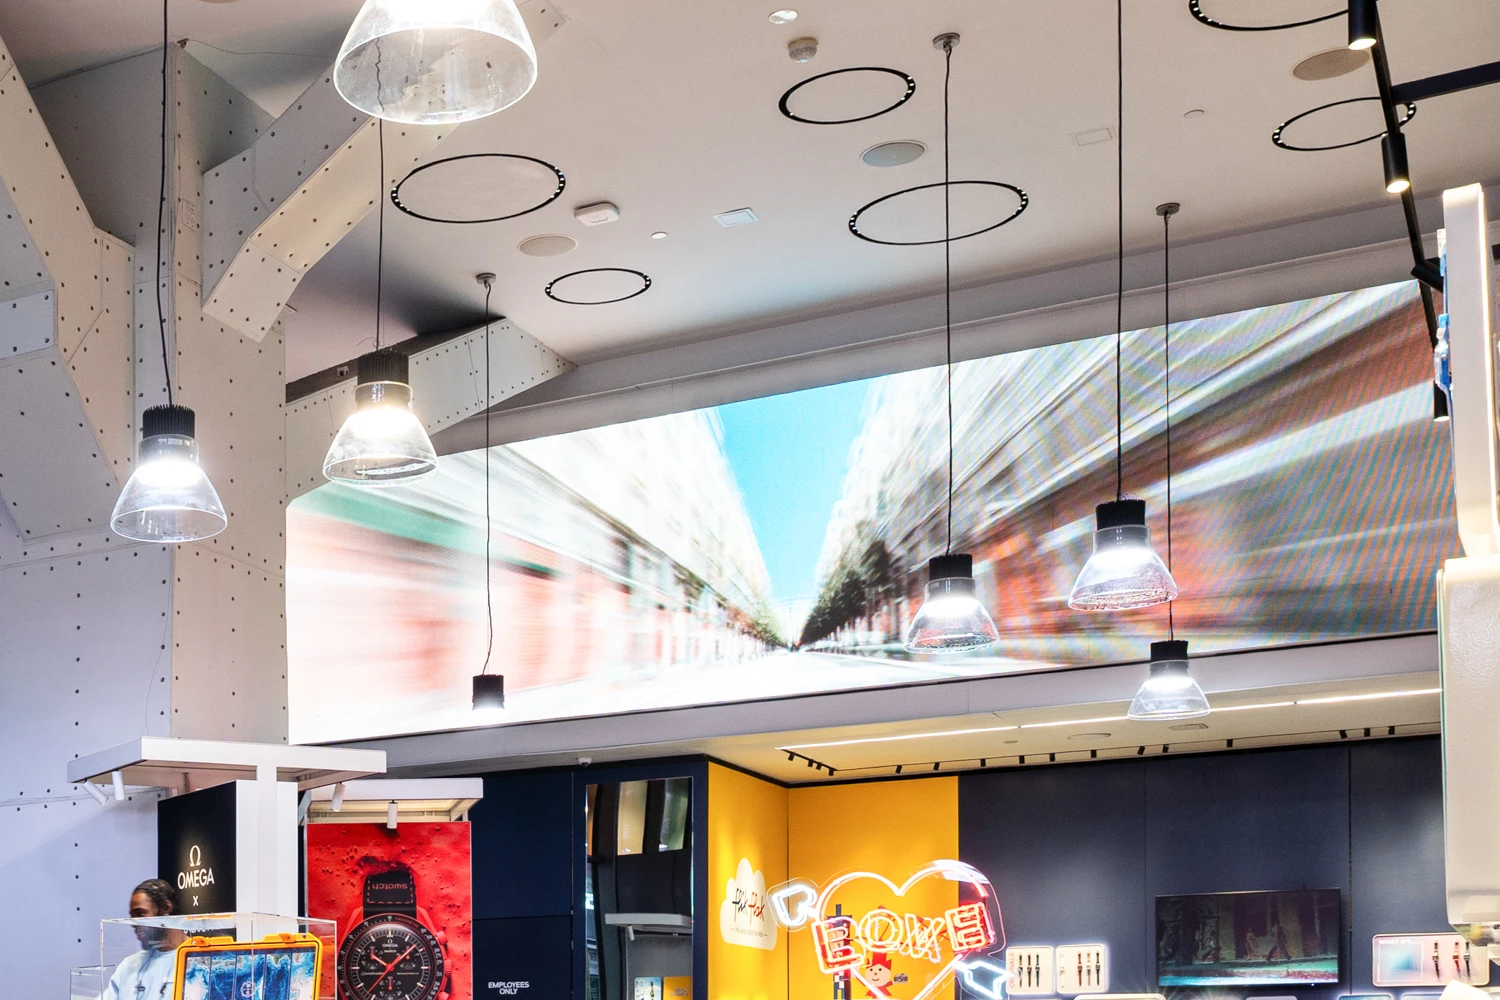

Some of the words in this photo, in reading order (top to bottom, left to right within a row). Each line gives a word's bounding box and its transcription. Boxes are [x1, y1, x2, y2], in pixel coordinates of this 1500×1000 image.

[177, 867, 215, 890] OMEGA
[371, 882, 408, 890] swatch
[488, 981, 530, 989] EMPLOYEES
